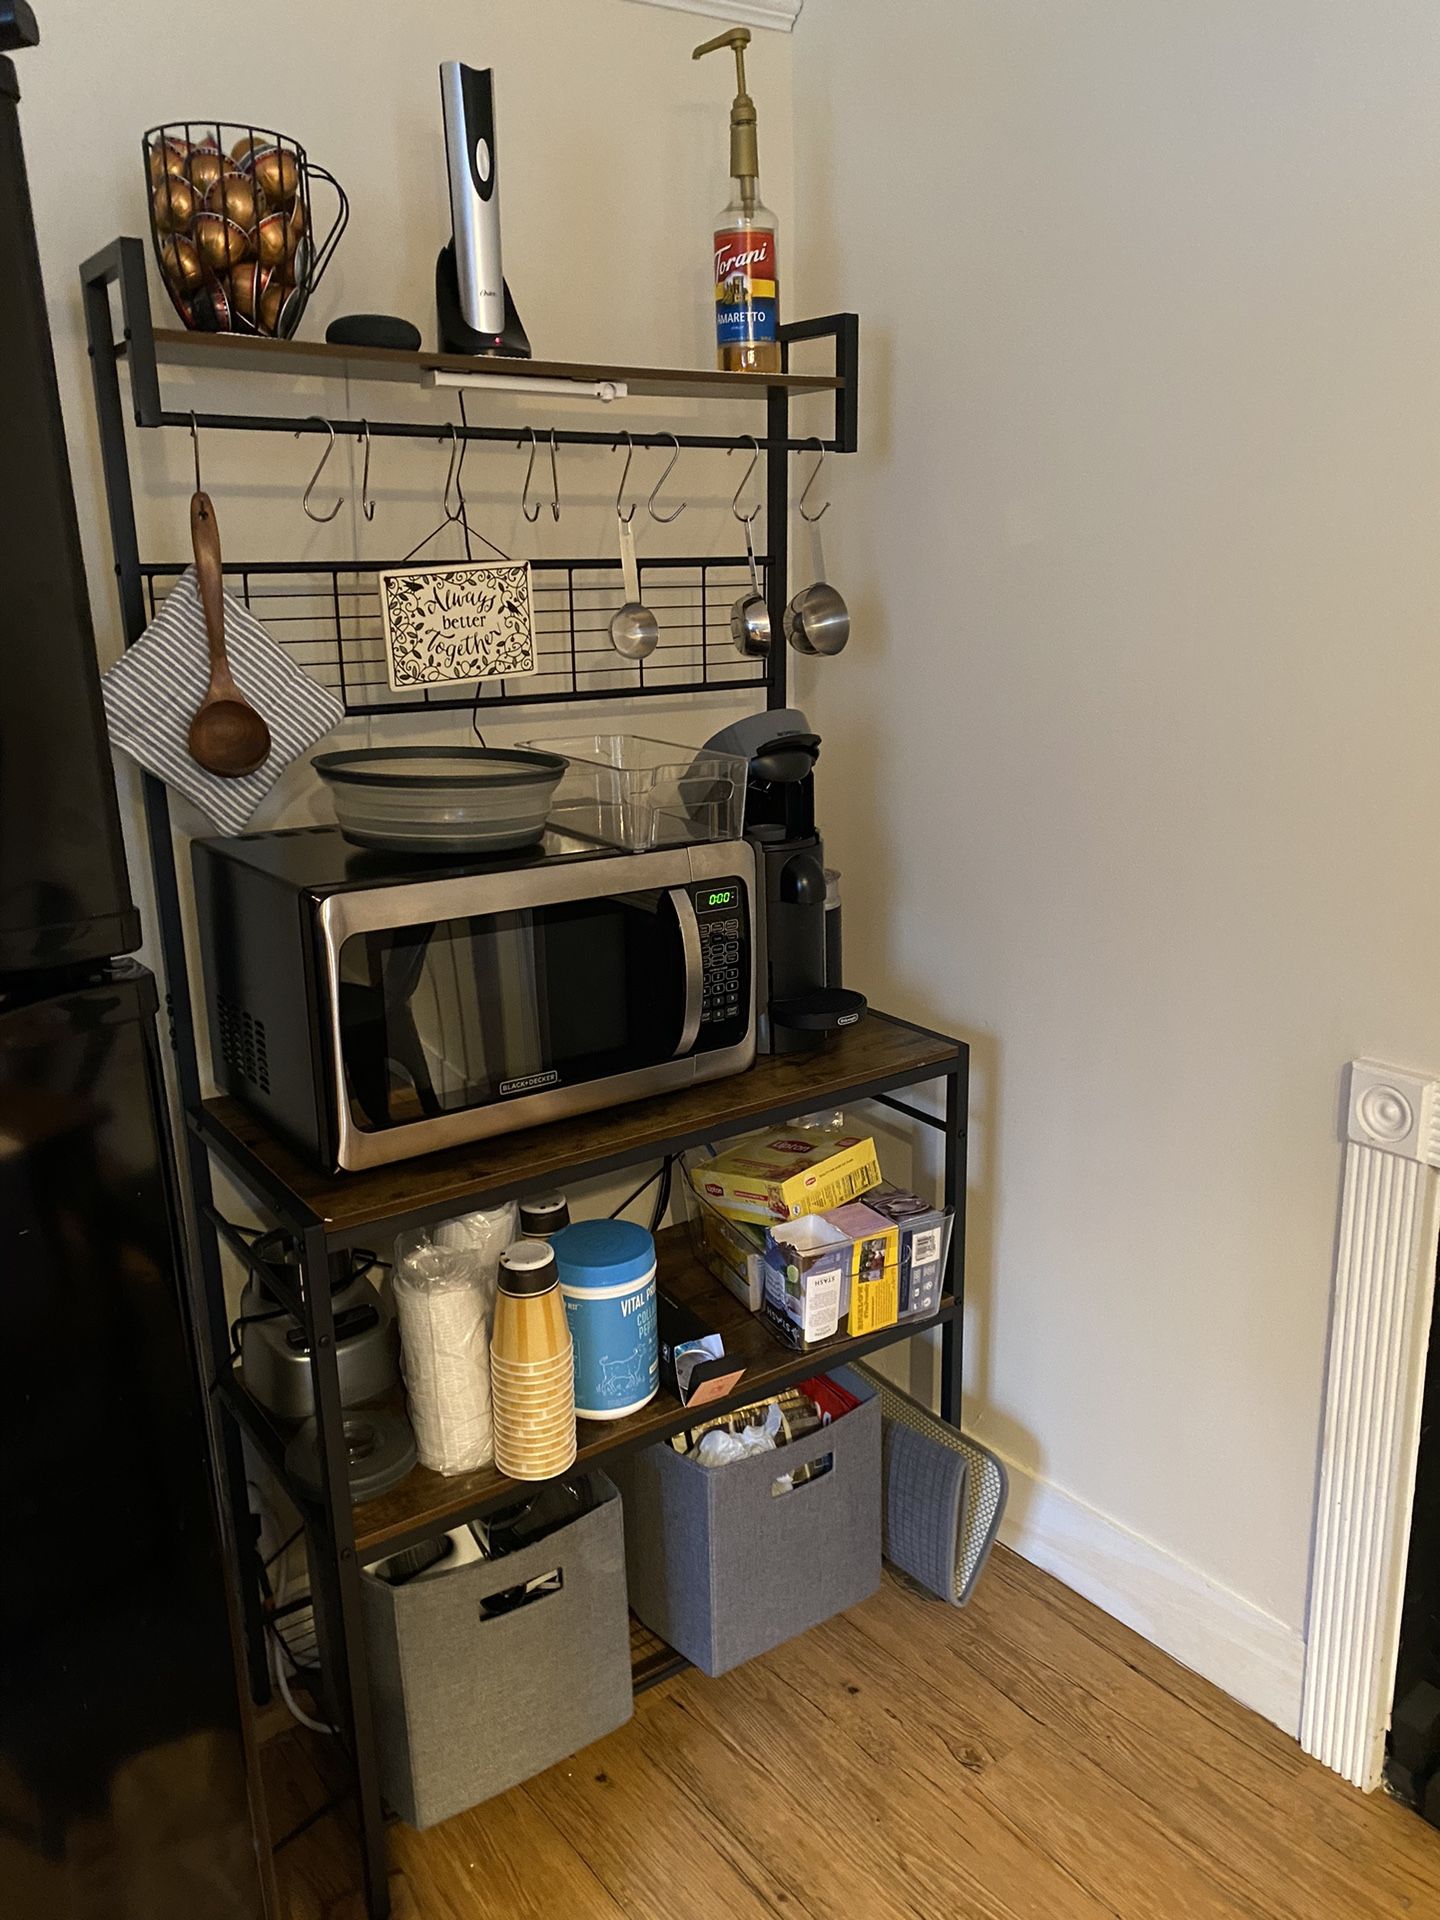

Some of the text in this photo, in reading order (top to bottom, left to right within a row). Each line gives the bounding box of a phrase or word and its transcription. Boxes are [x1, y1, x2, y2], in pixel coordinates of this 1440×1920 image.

[714, 243, 768, 285] Torani
[717, 311, 766, 324] AMARETTO
[424, 587, 497, 615] Always
[442, 615, 487, 630] better
[425, 622, 502, 668] Together
[709, 892, 730, 905] 0:00
[502, 1074, 555, 1092] BLACK+DECKER
[814, 1275, 836, 1287] STASH
[620, 1293, 645, 1318] VITAL
